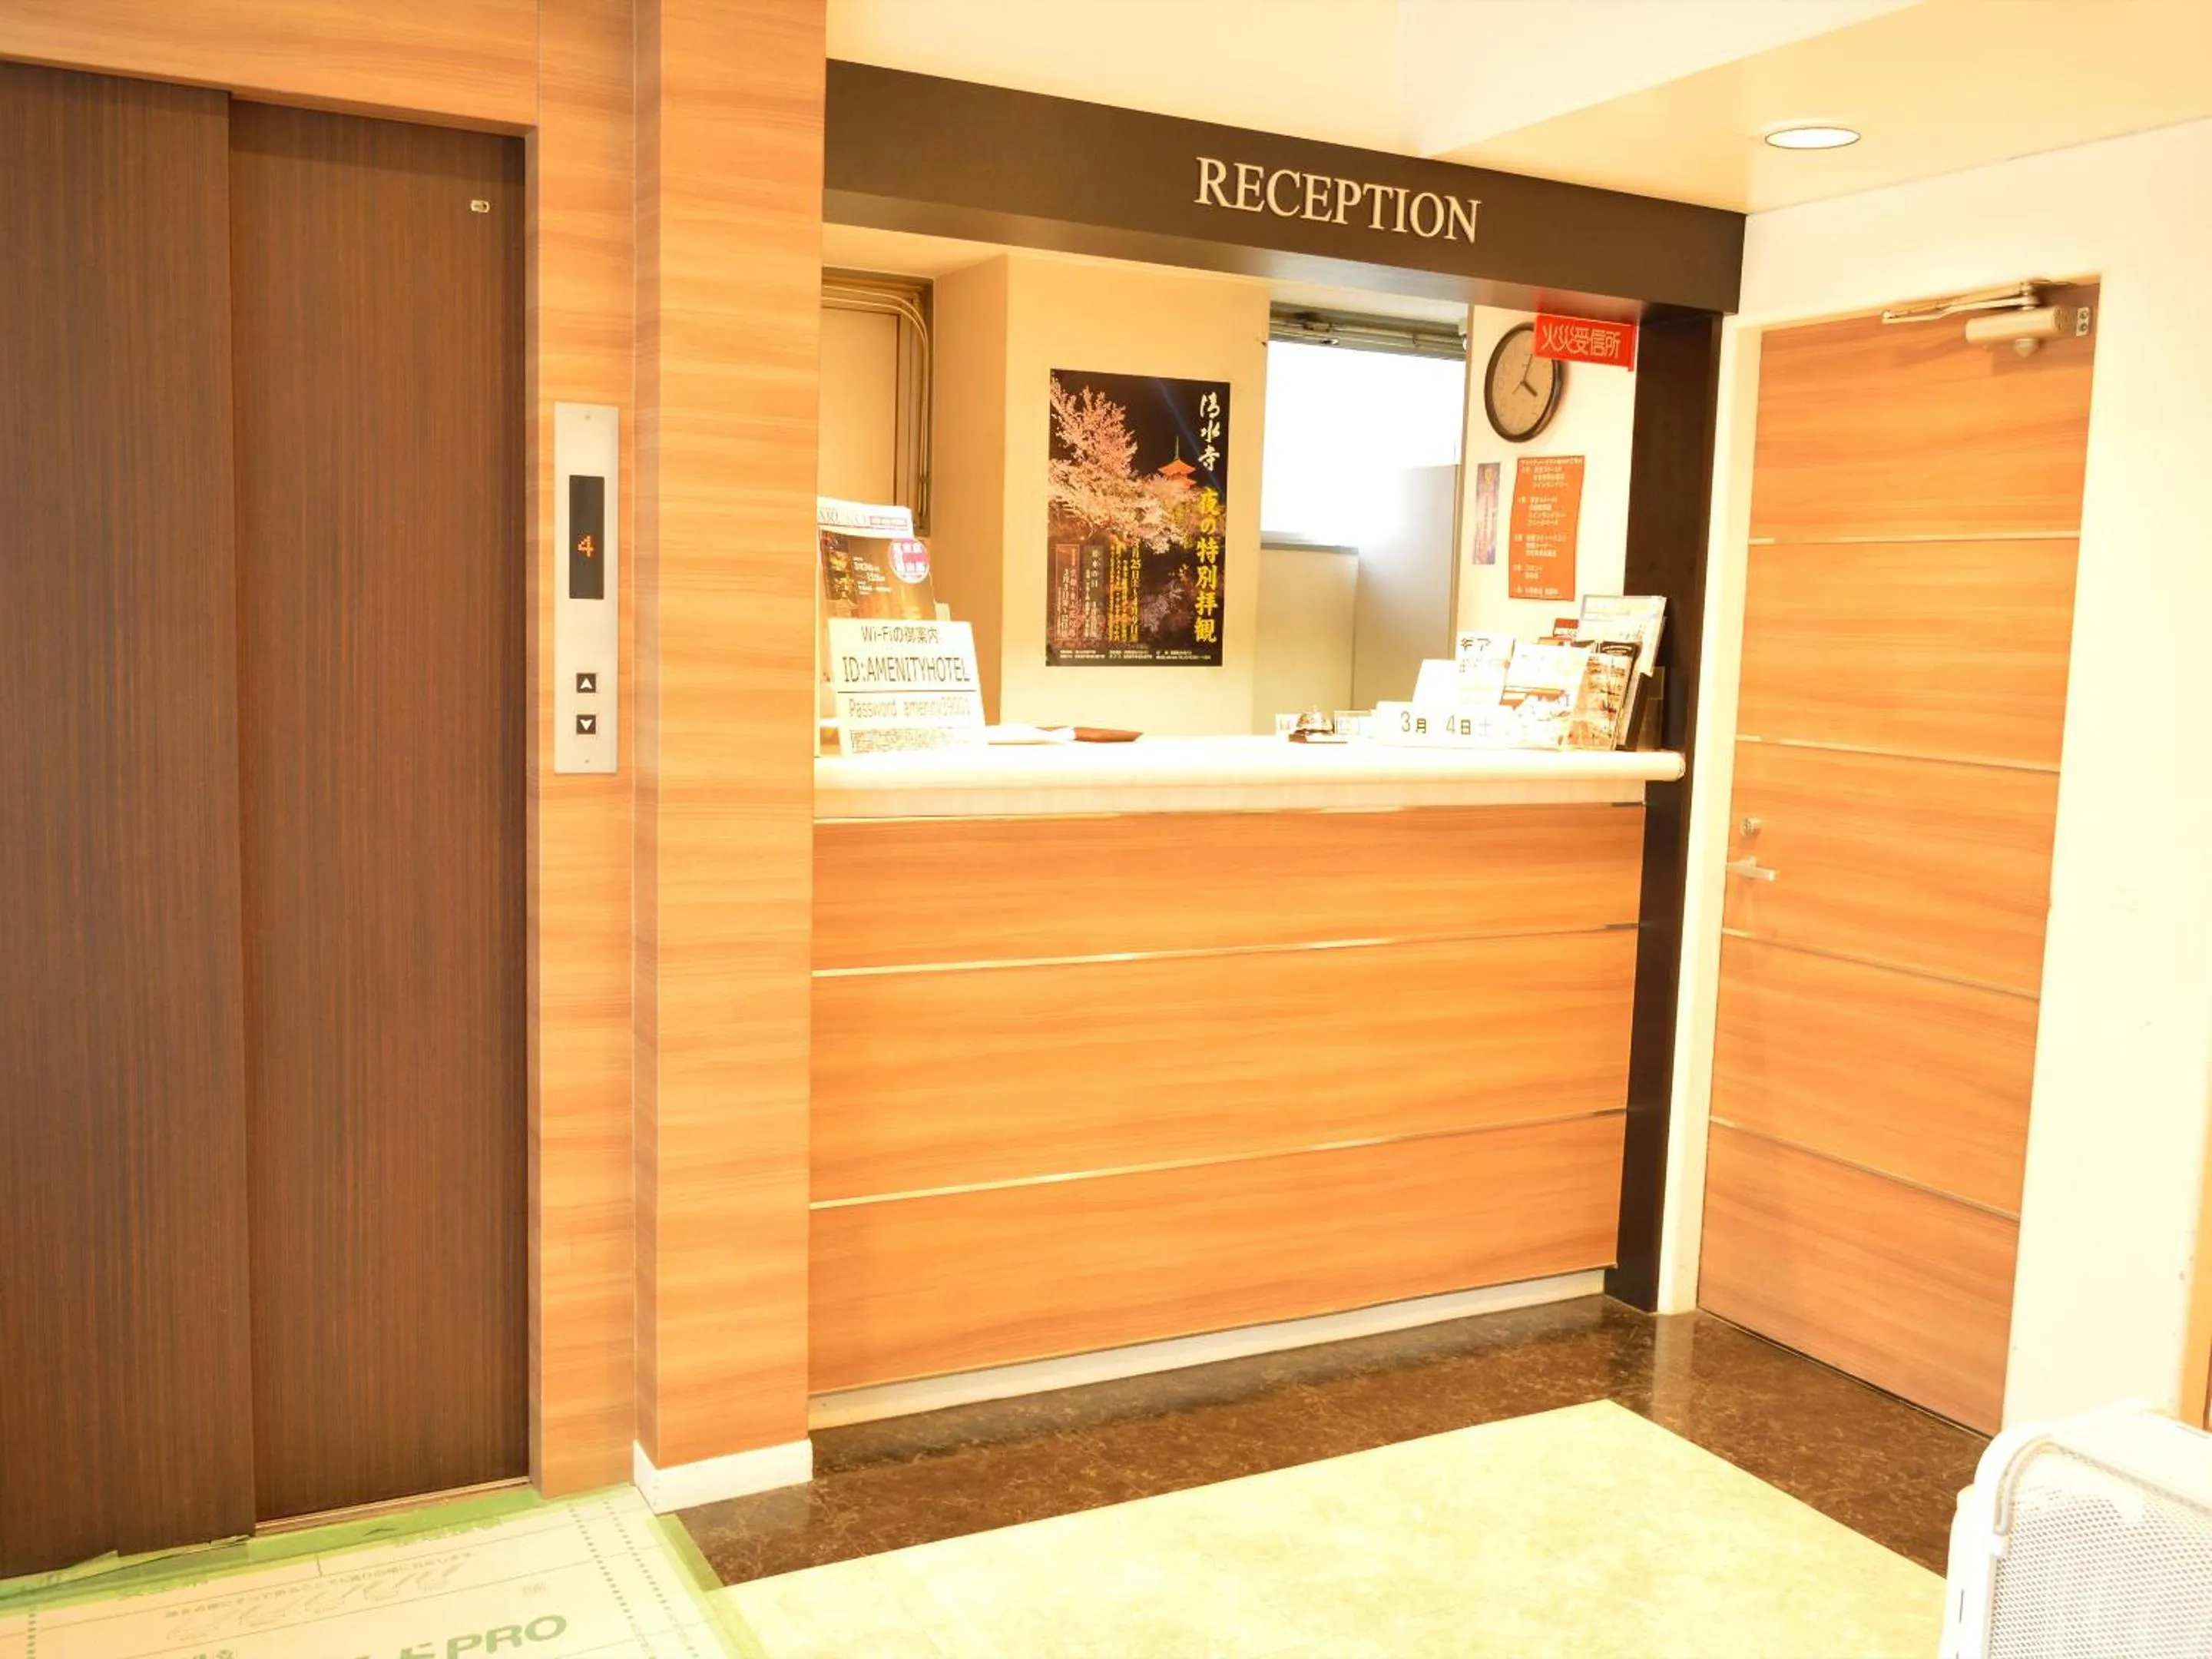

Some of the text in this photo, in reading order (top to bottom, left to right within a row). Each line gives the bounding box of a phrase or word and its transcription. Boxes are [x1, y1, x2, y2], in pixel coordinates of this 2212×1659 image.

[1194, 157, 1482, 243] RECEPTION
[1541, 323, 1621, 359] 火災受信所
[1199, 392, 1220, 472] 清水寺
[578, 535, 594, 557] 4
[1194, 487, 1220, 643] 夜の特別拝観
[842, 657, 971, 682] ID:AMENITYHOTEL
[849, 697, 897, 719] Password
